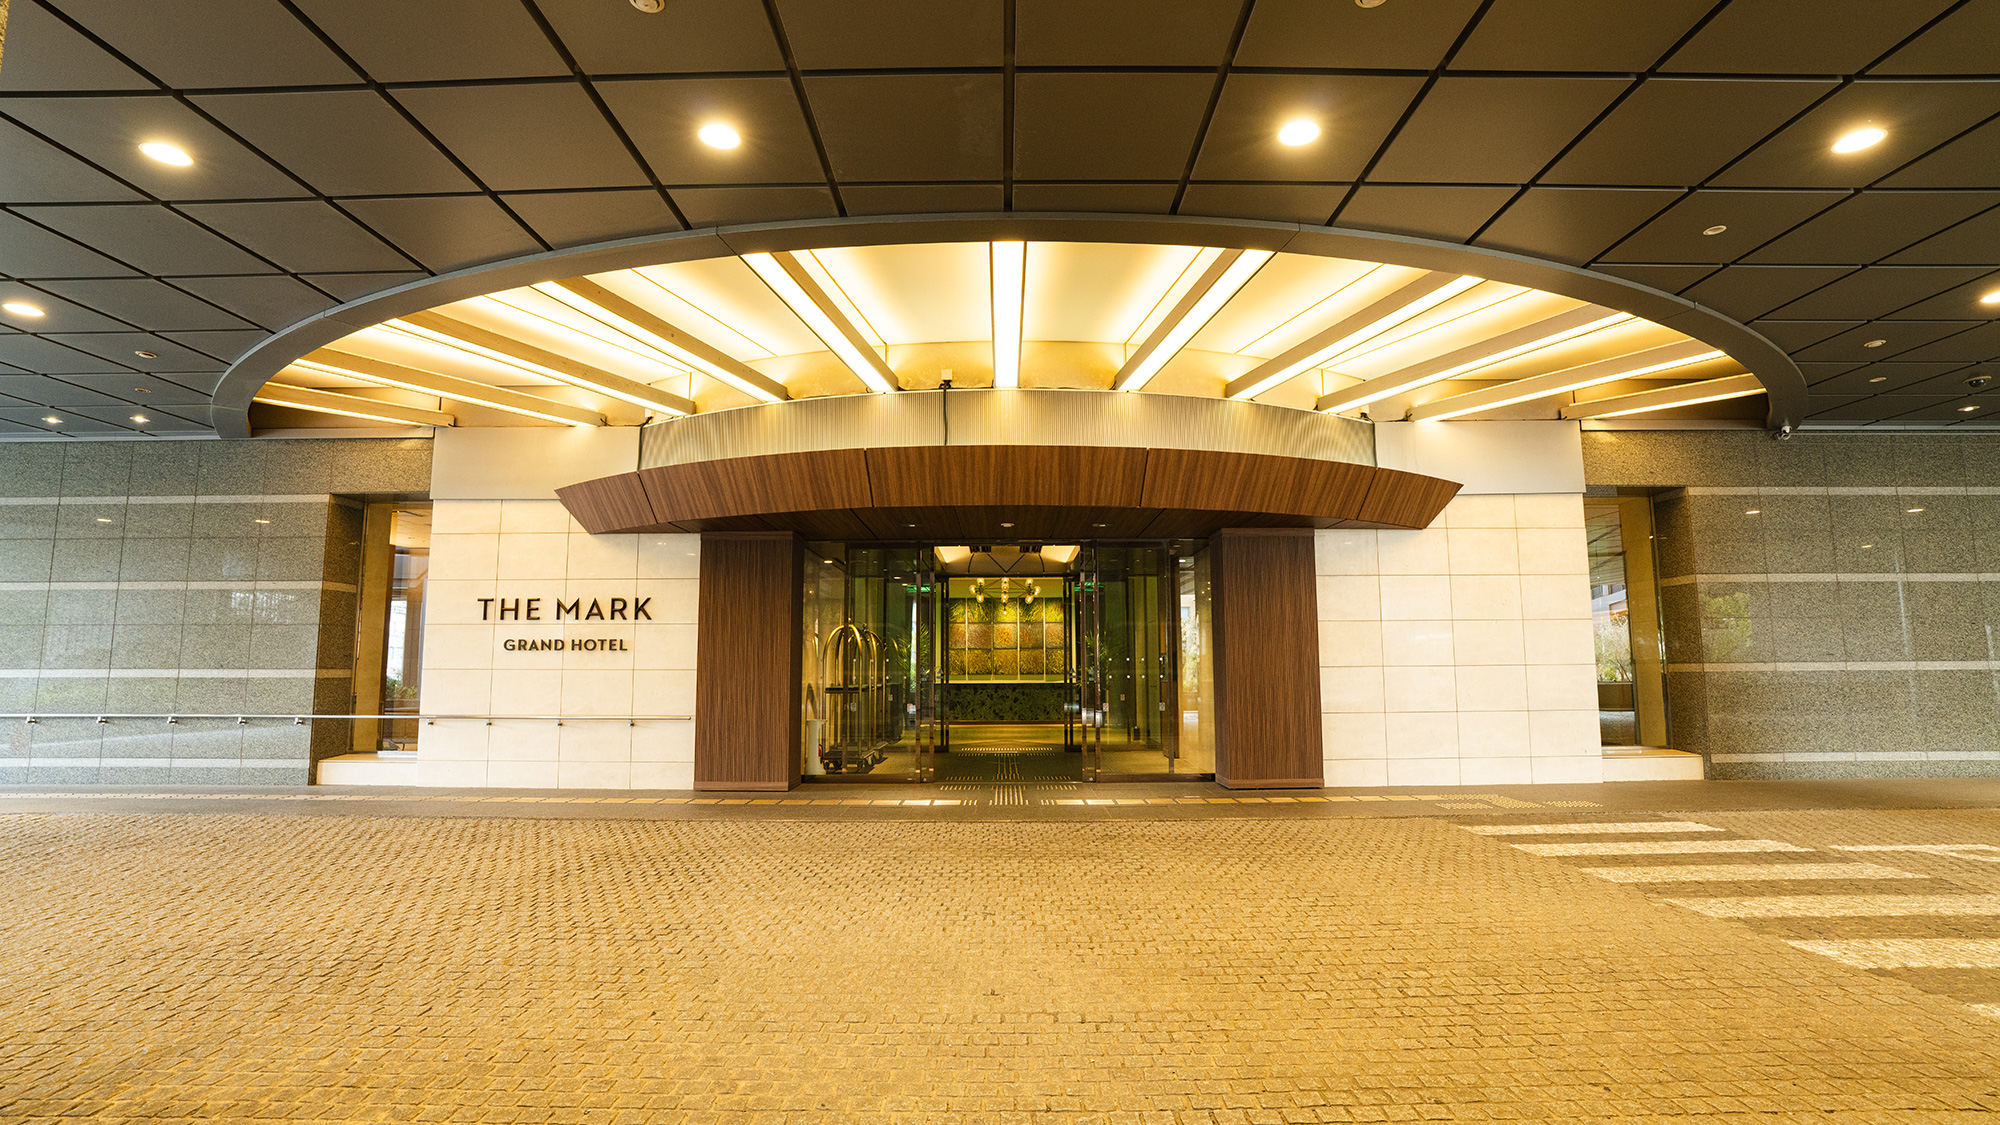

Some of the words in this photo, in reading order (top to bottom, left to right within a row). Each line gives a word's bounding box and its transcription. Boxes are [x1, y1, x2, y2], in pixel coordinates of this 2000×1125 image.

[477, 598, 541, 621] THE
[556, 597, 653, 621] MARK
[503, 638, 565, 651] GRAND
[571, 638, 628, 651] HOTEL
